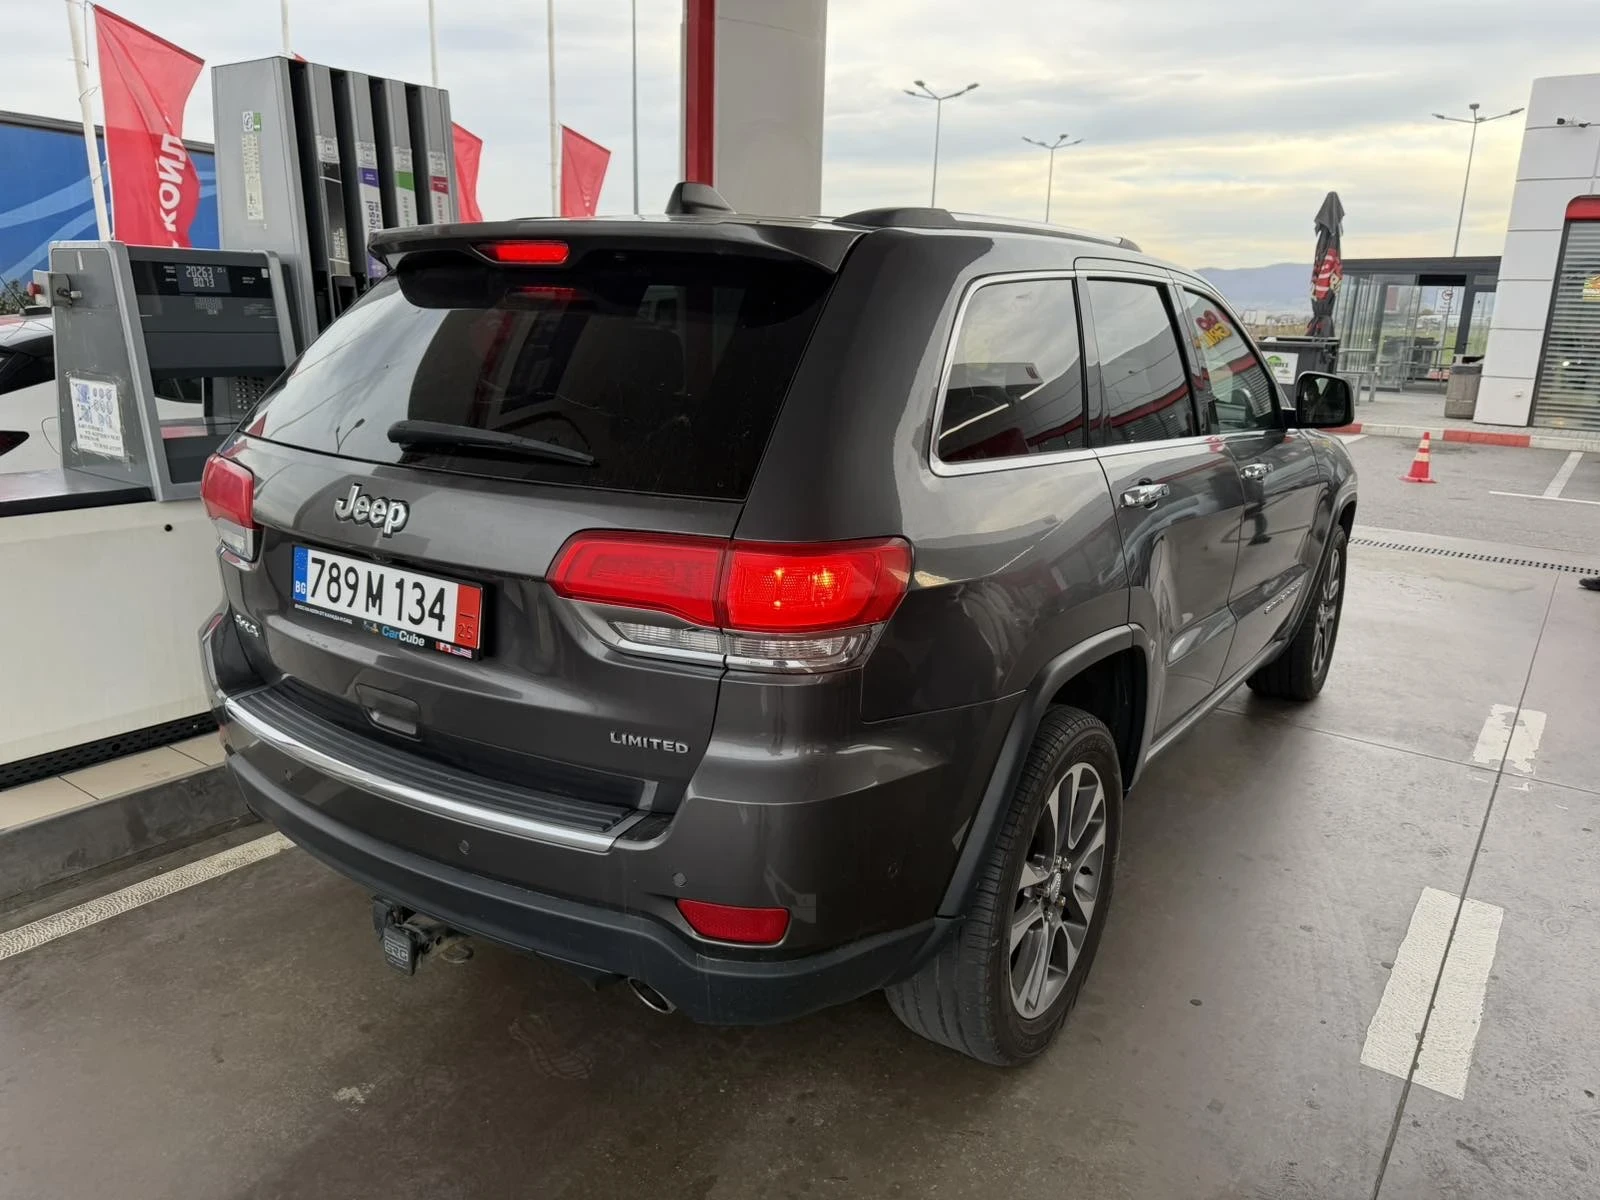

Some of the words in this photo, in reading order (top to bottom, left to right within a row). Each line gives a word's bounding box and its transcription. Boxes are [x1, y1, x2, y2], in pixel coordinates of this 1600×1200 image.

[155, 133, 187, 248] КОЙЛ
[333, 483, 410, 538] Jeep
[295, 581, 307, 595] BG
[310, 557, 360, 608] 789
[365, 570, 384, 616] M
[395, 578, 446, 632] 134
[381, 626, 425, 647] CarCube
[458, 623, 474, 640] 25
[610, 731, 689, 754] LIMITED
